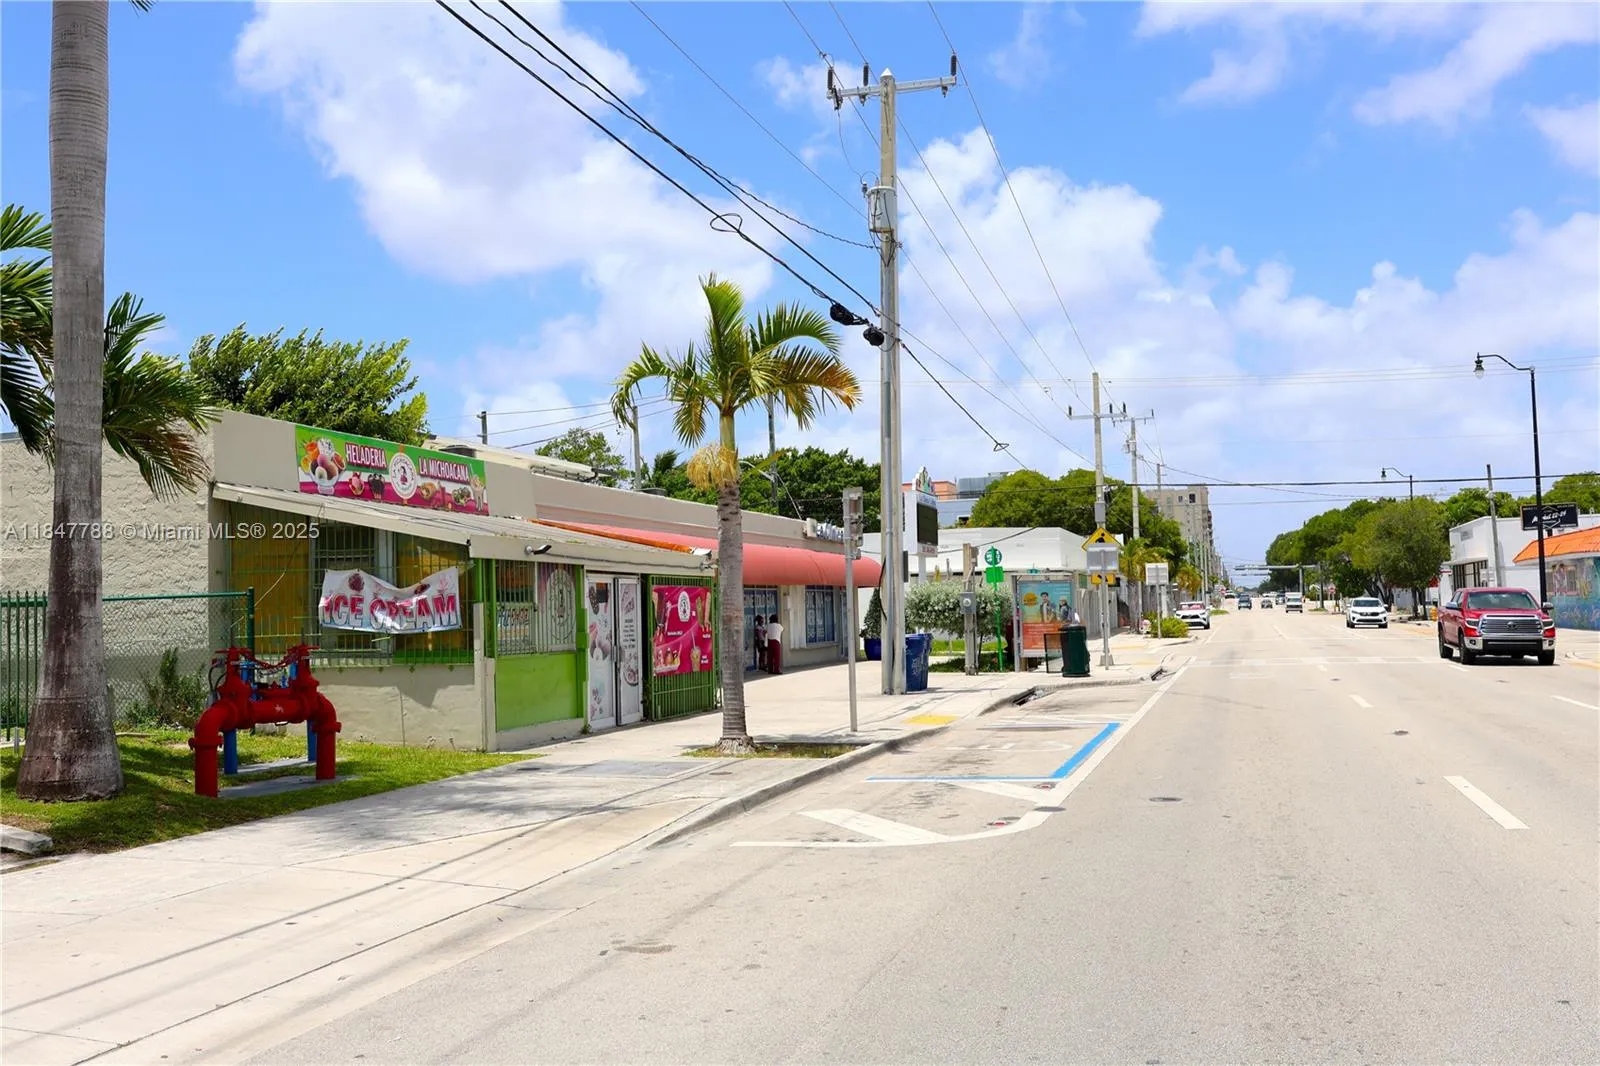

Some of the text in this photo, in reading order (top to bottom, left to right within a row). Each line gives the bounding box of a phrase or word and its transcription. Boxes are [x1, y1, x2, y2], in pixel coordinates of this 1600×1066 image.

[345, 443, 387, 469] HELADERIA
[418, 456, 428, 476] LA
[429, 459, 470, 482] MICHOACANA
[321, 594, 365, 628] ICE
[369, 594, 459, 631] CREAM
